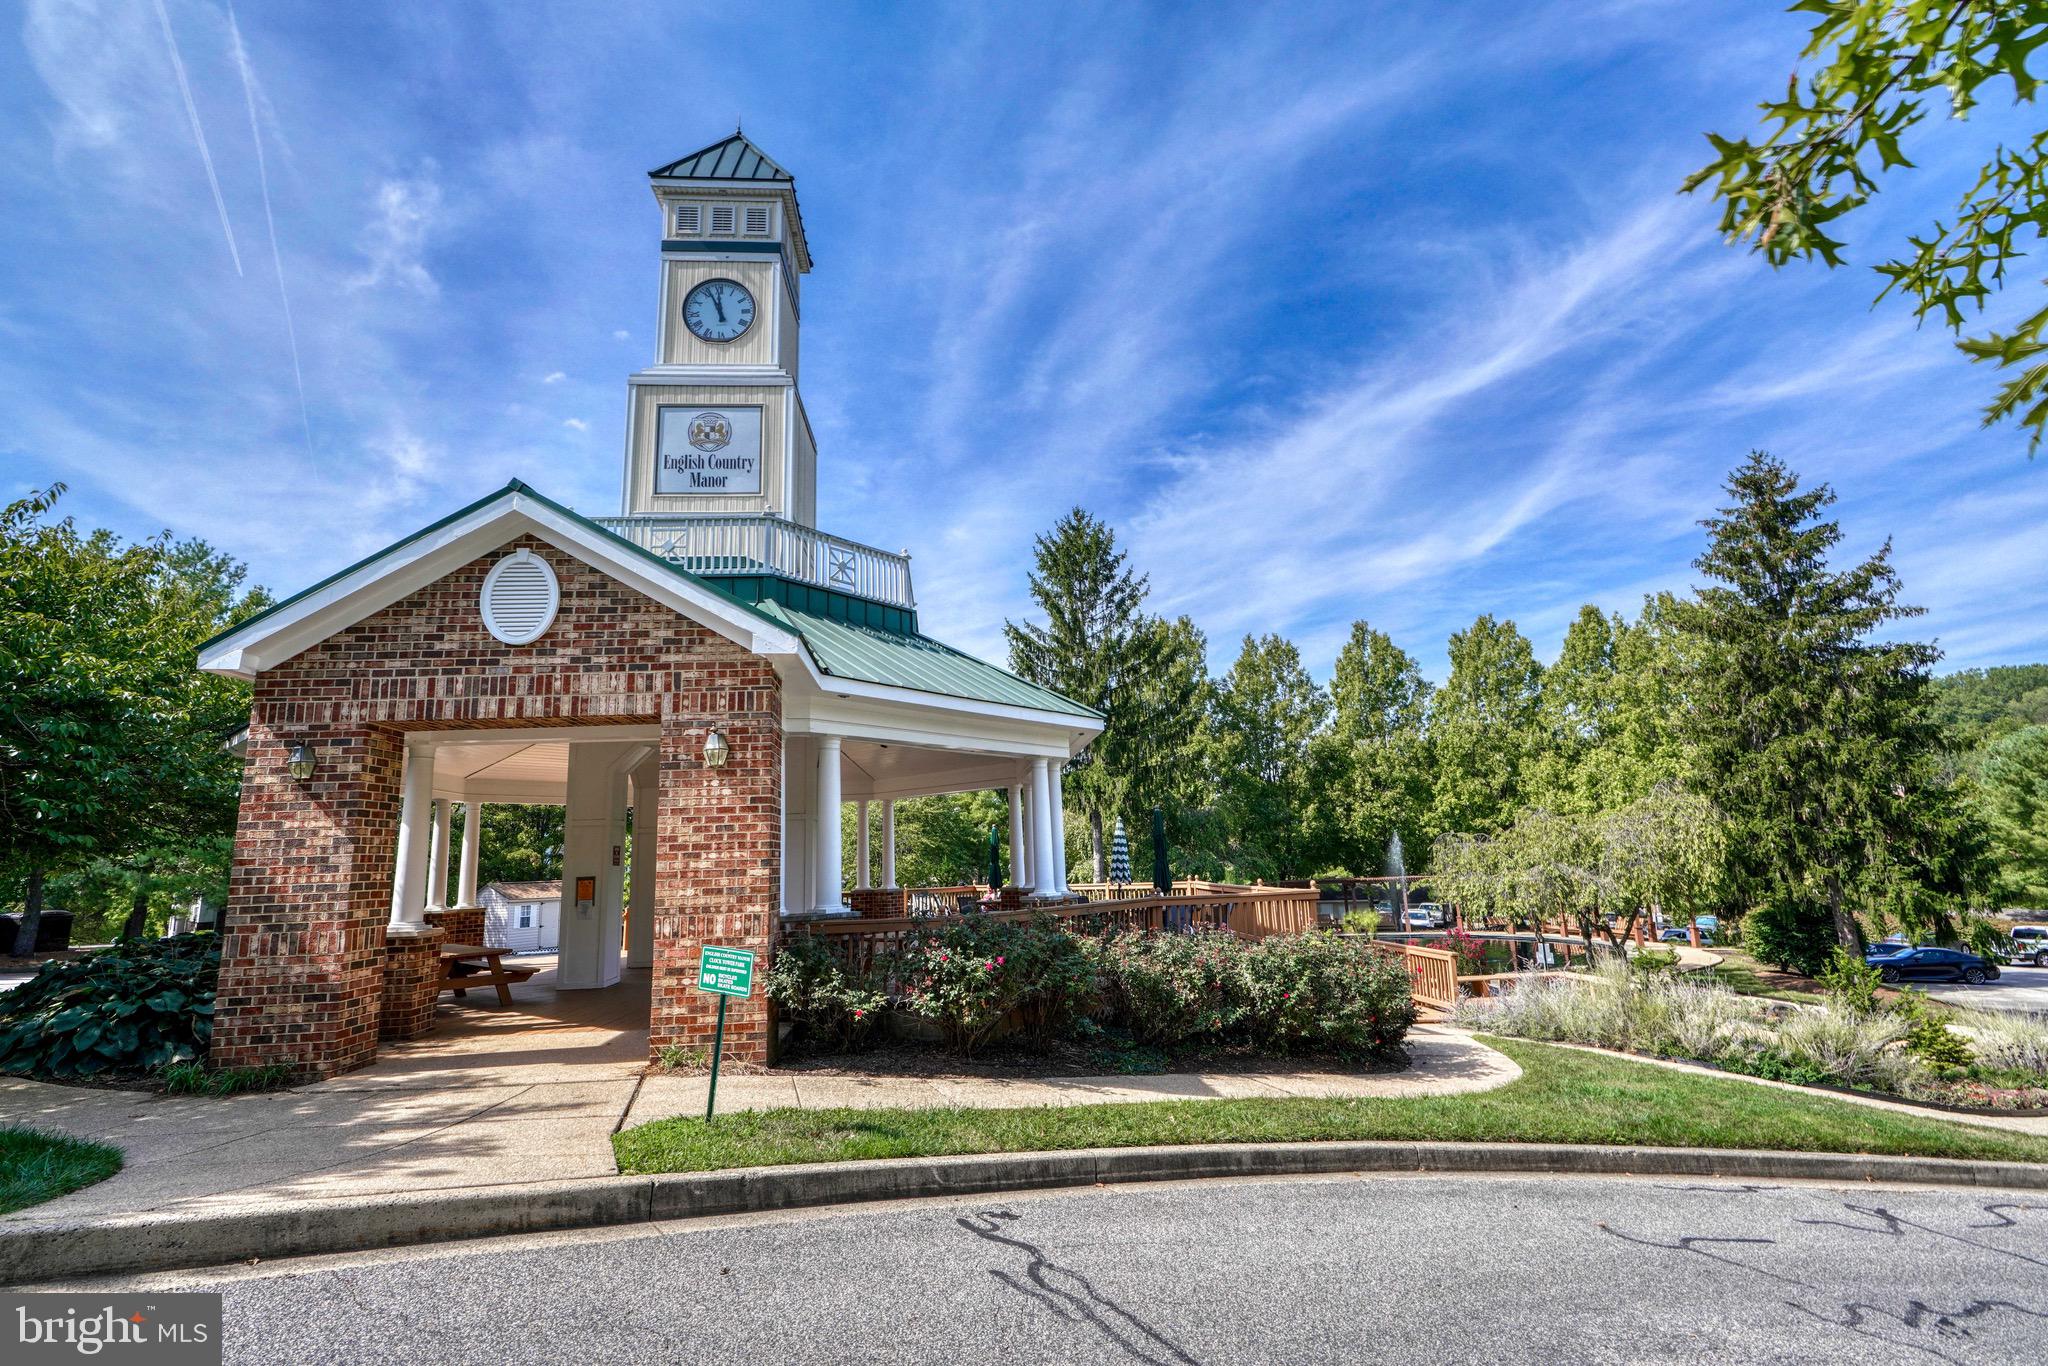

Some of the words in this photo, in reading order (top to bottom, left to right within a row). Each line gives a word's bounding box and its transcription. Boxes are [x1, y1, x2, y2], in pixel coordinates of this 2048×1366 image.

[664, 454, 704, 474] English
[708, 454, 754, 473] Country
[689, 472, 728, 488] Manor
[703, 973, 716, 984] NO
